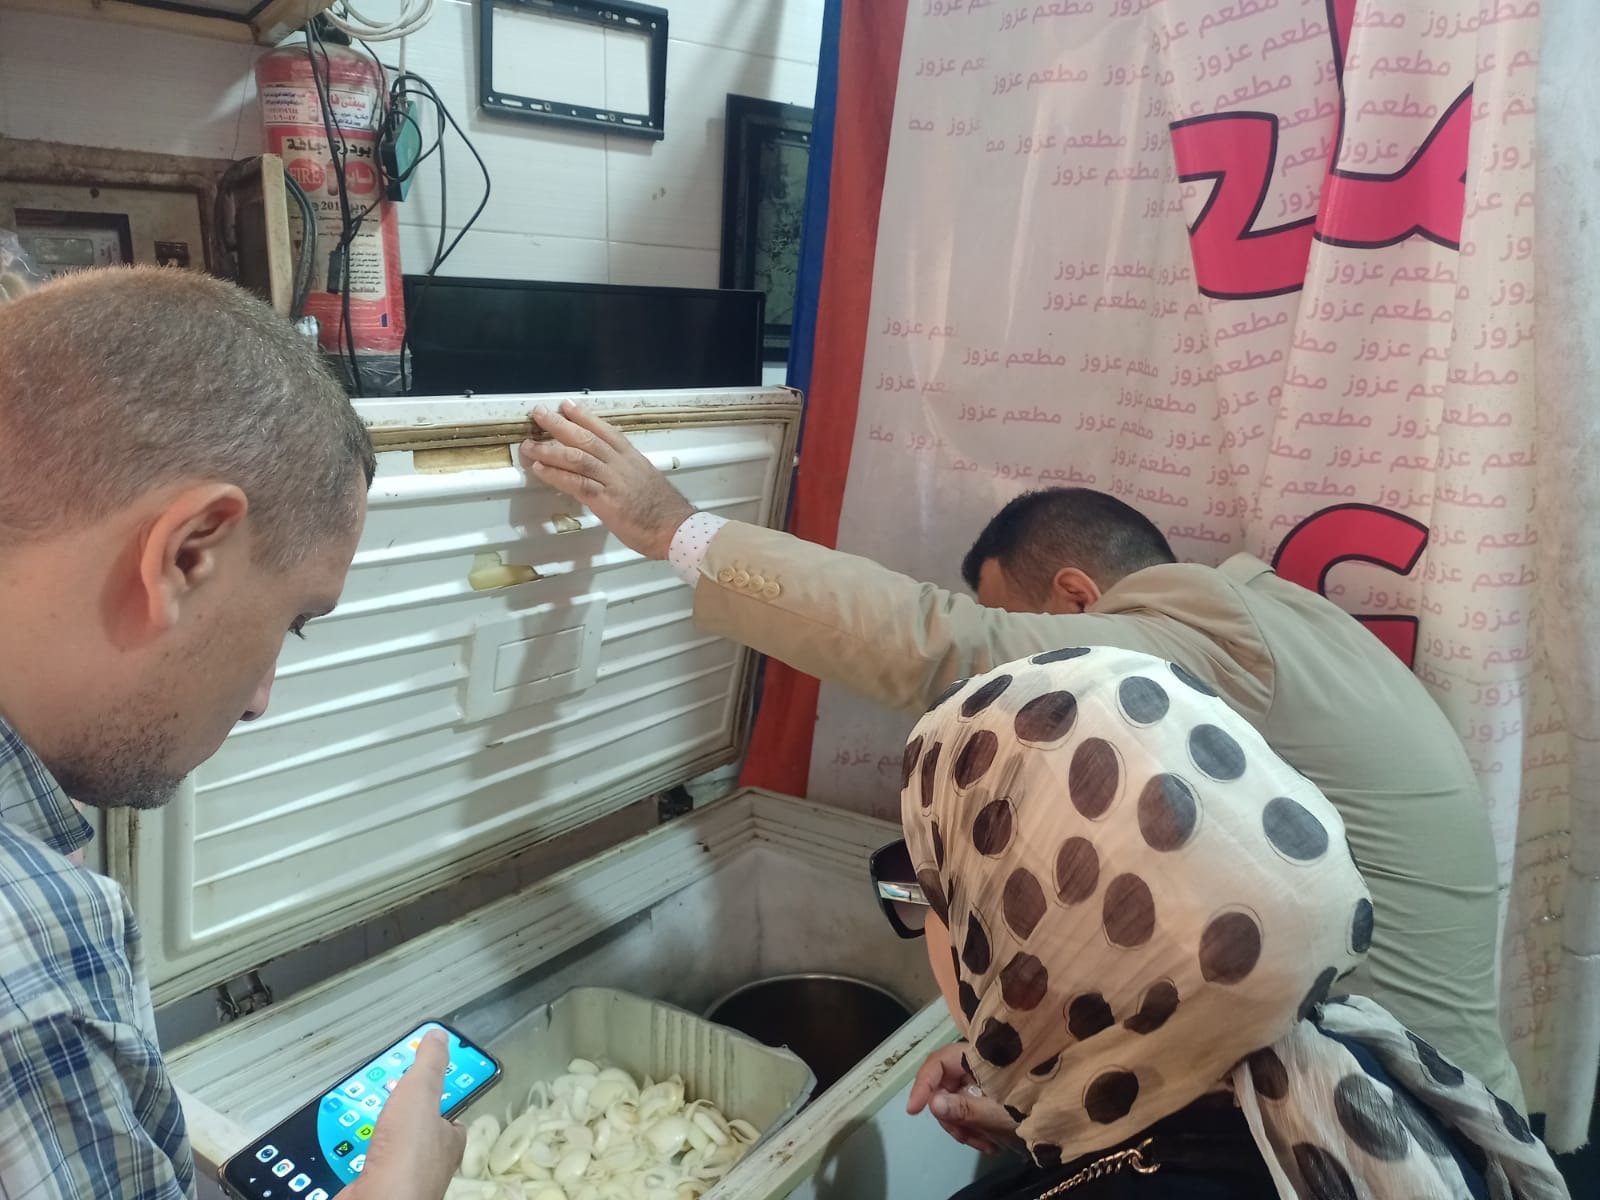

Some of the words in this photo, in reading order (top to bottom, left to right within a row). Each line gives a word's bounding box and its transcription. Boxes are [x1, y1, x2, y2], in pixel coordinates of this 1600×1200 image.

[999, 7, 1027, 31] عزوز
[1032, 0, 1094, 25] مطعم
[1354, 4, 1405, 28] مط
[1262, 17, 1328, 59] طعم
[916, 57, 955, 76] عزوز
[1195, 44, 1251, 81] عزوز
[1369, 50, 1450, 79] مطعم
[993, 74, 1022, 95] عزوز
[1027, 64, 1088, 91] مطعم
[1214, 75, 1292, 112] مطعم
[1279, 97, 1337, 130] طعم
[1356, 93, 1438, 122] مطعم
[1015, 133, 1056, 155] عزوز
[1063, 129, 1127, 155] مطعم
[1340, 138, 1399, 164] عزوز
[1052, 167, 1098, 186] عزوز
[1104, 160, 1158, 187] مطعم
[321, 201, 341, 212] 201
[1054, 261, 1099, 280] عزوز
[1327, 260, 1384, 284] عزوز
[1389, 261, 1457, 287] طعم
[1043, 291, 1088, 312] عزوز
[1093, 291, 1146, 313] مطعم
[1306, 298, 1364, 322] عزوز
[1370, 299, 1451, 325] مطعم
[882, 317, 922, 337] عزوز
[1215, 312, 1288, 347] مطعم
[1293, 329, 1336, 353] مط
[1354, 338, 1411, 362] عزوز
[962, 348, 1001, 366] عزوز
[1005, 348, 1066, 369] مطعم
[1080, 354, 1122, 373] عزوز
[1126, 358, 1159, 378] مطعم
[875, 372, 916, 392] عزوز
[1285, 366, 1327, 389] مط
[1342, 374, 1399, 397] عزوز
[957, 402, 997, 422] عزوز
[1002, 406, 1062, 426] مطعم
[1075, 412, 1116, 431] عزوز
[1296, 408, 1372, 430] مطعم
[1166, 428, 1211, 450] عزوز
[1269, 436, 1311, 460] مط
[1139, 456, 1191, 477] مطعم
[1327, 446, 1382, 467] عزوز
[1482, 442, 1536, 474] طعم
[992, 461, 1033, 480] عزوز
[1038, 465, 1096, 485] مطعم
[1136, 486, 1188, 507] مطعم
[1280, 477, 1356, 498] مطعم
[1168, 522, 1230, 544] مطعم
[1362, 584, 1416, 610] عزوز
[1459, 605, 1520, 632] عزوز
[1424, 632, 1472, 660] عزوز
[1464, 719, 1520, 743] عزوز
[832, 747, 872, 766] عزوز
